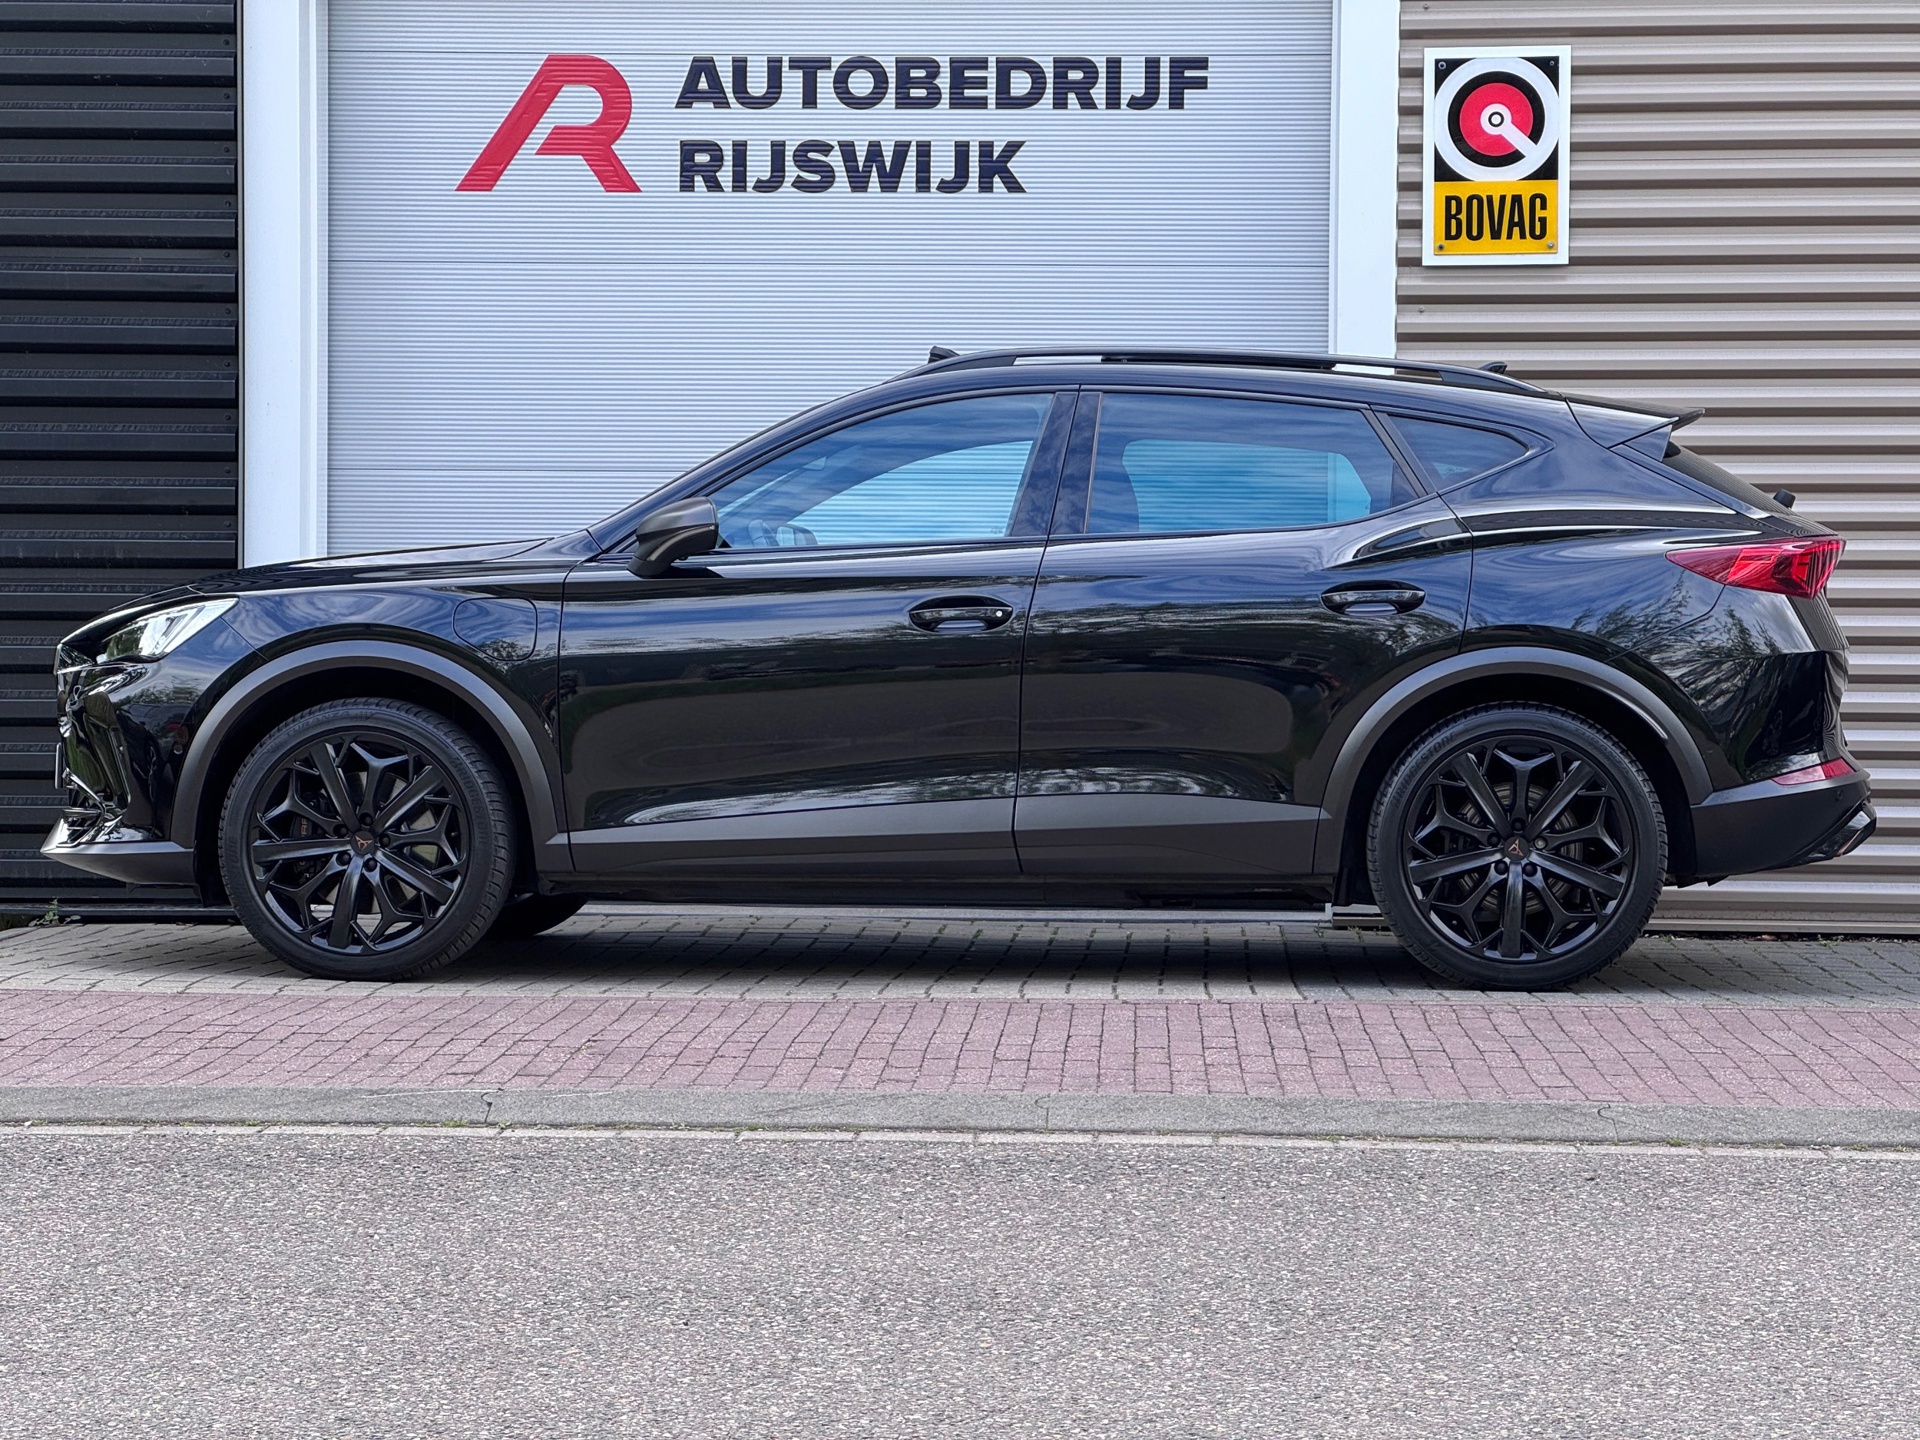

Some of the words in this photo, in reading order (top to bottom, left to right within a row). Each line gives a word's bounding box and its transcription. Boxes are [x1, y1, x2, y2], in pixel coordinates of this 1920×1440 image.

[674, 56, 1210, 110] AUTOBEDRIJF
[679, 139, 1028, 194] RIJSWIJK
[1444, 192, 1548, 242] BOVAG
